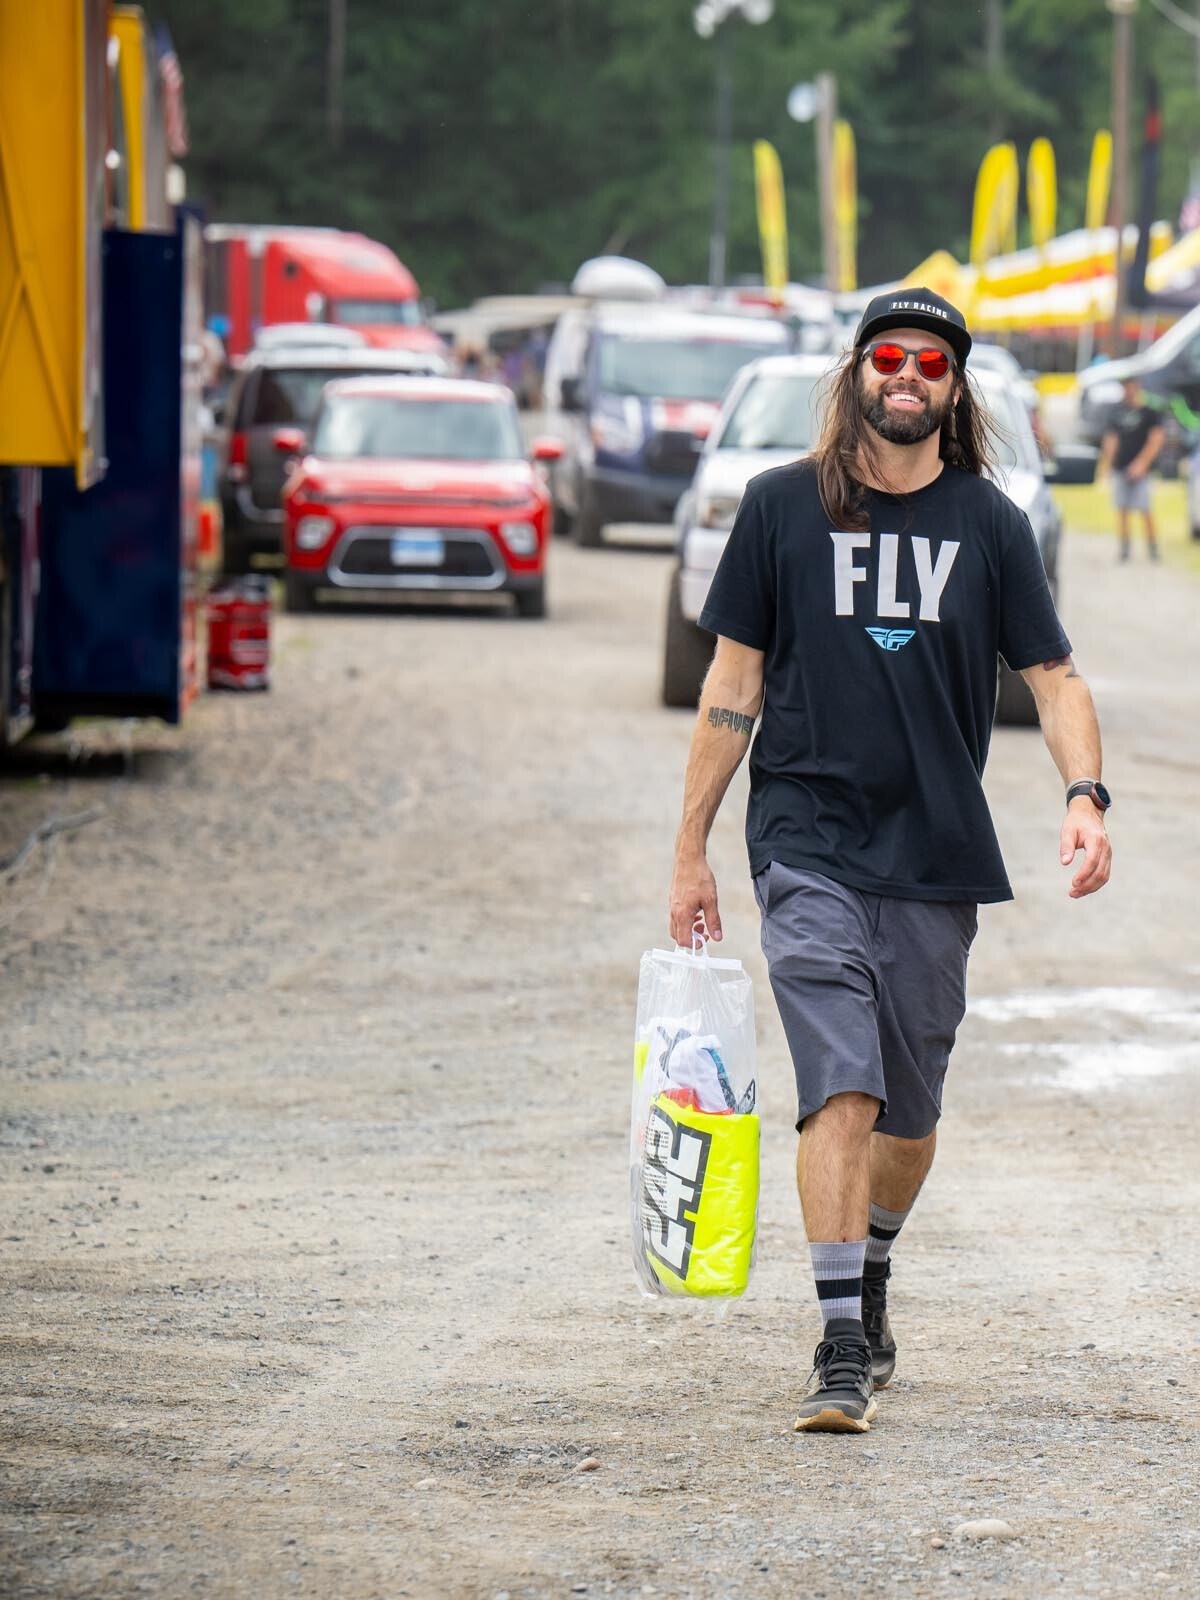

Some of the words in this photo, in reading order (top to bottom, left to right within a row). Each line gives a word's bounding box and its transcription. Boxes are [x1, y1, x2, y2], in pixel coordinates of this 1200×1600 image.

[892, 302, 910, 310] FLY
[913, 302, 948, 319] RACING
[829, 532, 961, 623] FLY
